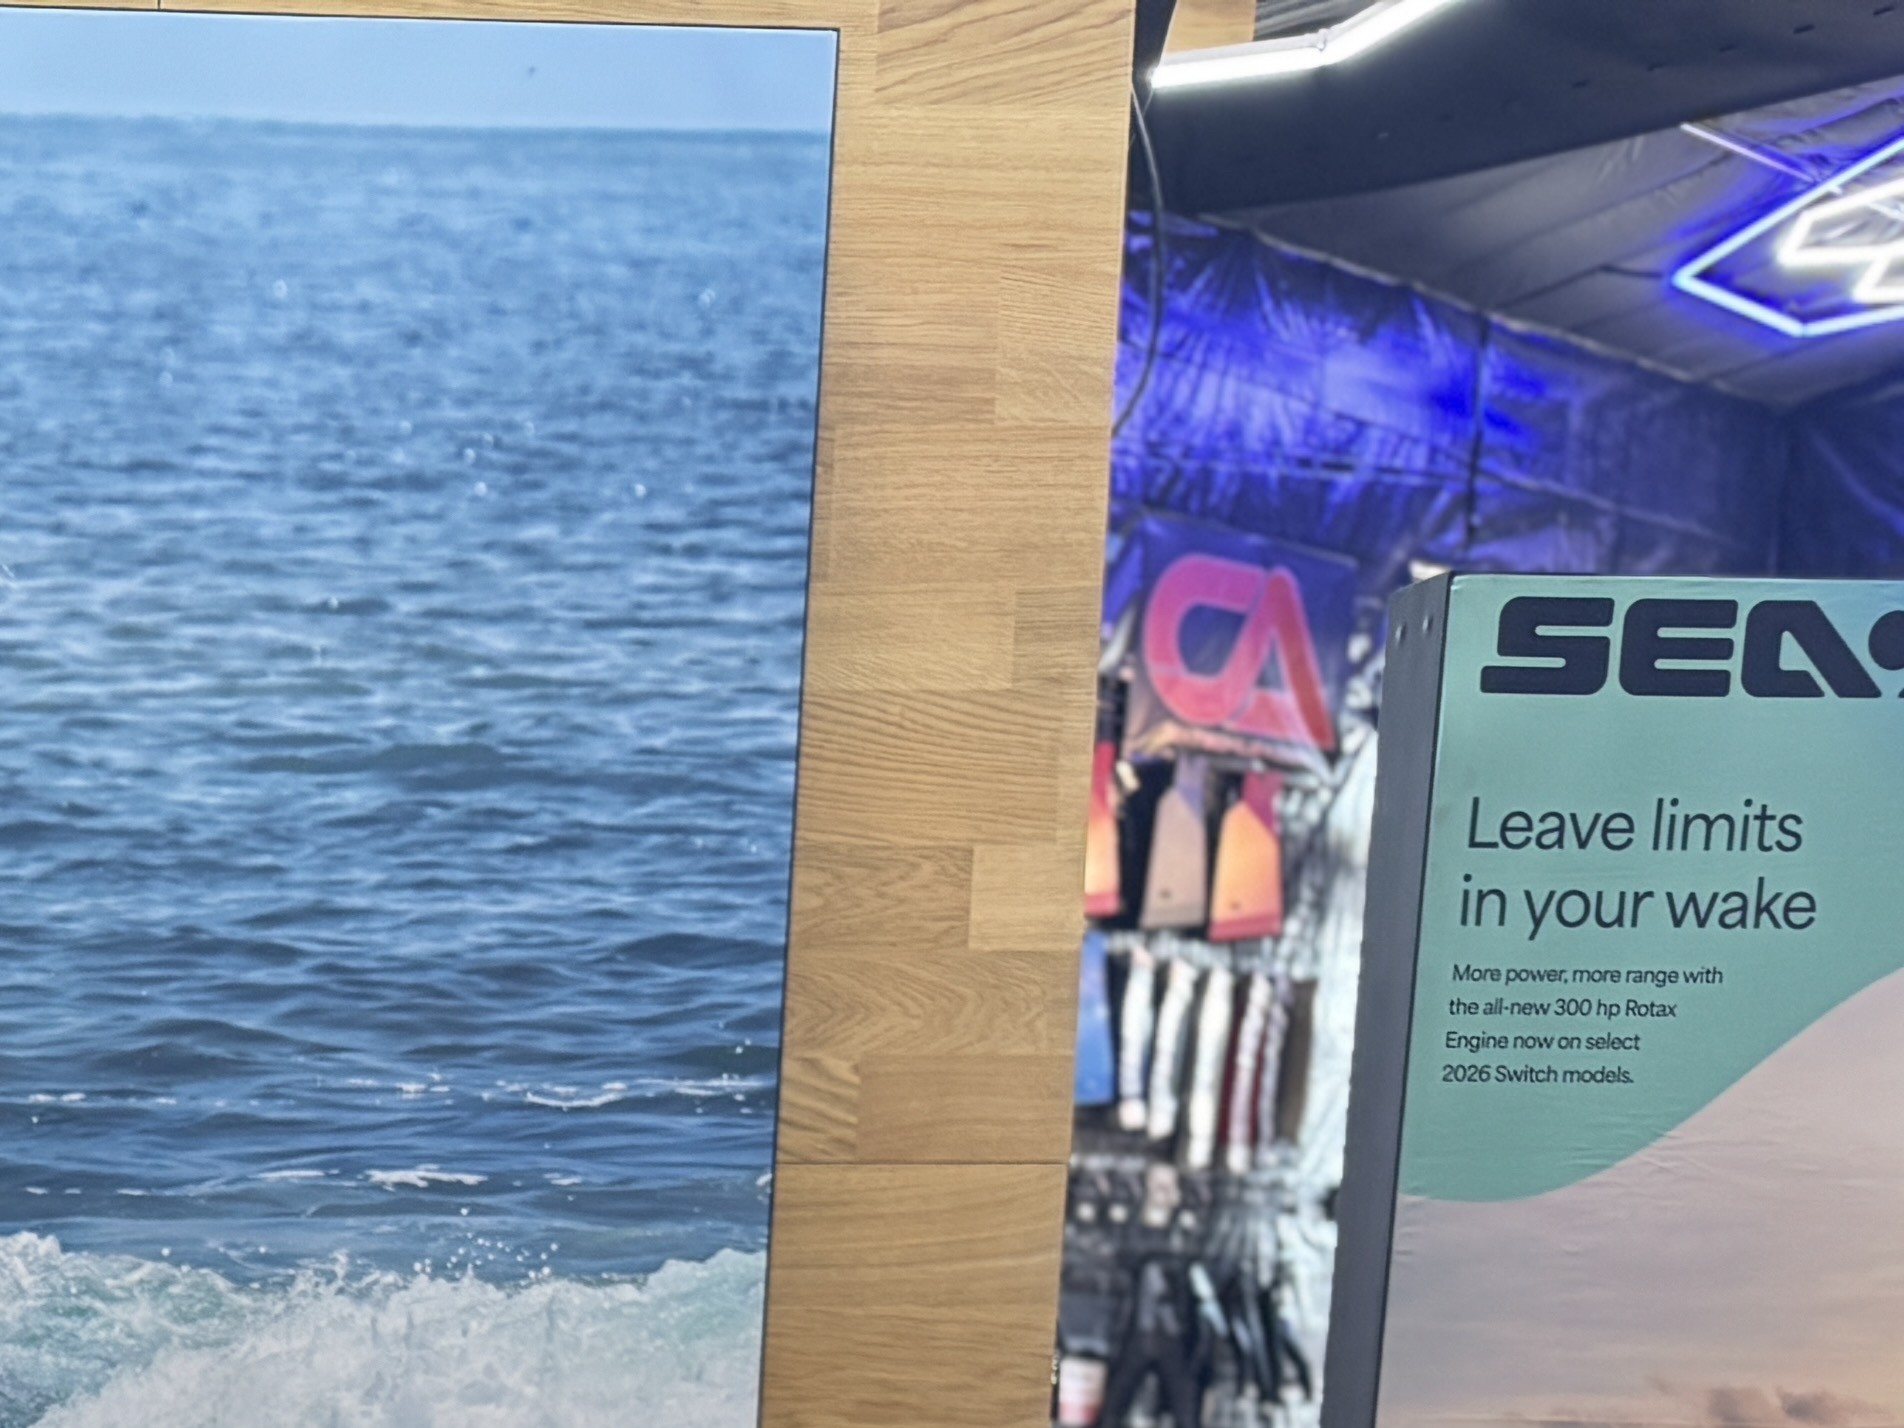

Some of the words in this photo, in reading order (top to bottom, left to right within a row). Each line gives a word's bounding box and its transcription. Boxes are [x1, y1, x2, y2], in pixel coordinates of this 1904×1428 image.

[1467, 798, 1635, 851] Leave
[1652, 798, 1803, 852] limits
[1460, 873, 1506, 927] in
[1524, 887, 1653, 940] your
[1666, 877, 1817, 929] wake
[1452, 963, 1501, 982] More
[1505, 967, 1569, 986] power,
[1572, 968, 1621, 983] more
[1625, 969, 1679, 987] range
[1683, 966, 1723, 984] with
[1449, 997, 1479, 1016] the
[1482, 998, 1551, 1017] all-new
[1554, 998, 1592, 1017] 300
[1596, 1000, 1621, 1020] hp
[1625, 999, 1677, 1018] Rotax
[1445, 1030, 1509, 1053] Engine
[1513, 1034, 1555, 1050] now
[1558, 1035, 1582, 1051] on
[1585, 1031, 1640, 1051] select
[1442, 1064, 1491, 1083] 2026
[1494, 1064, 1558, 1084] Switch
[1562, 1065, 1634, 1085] models.
